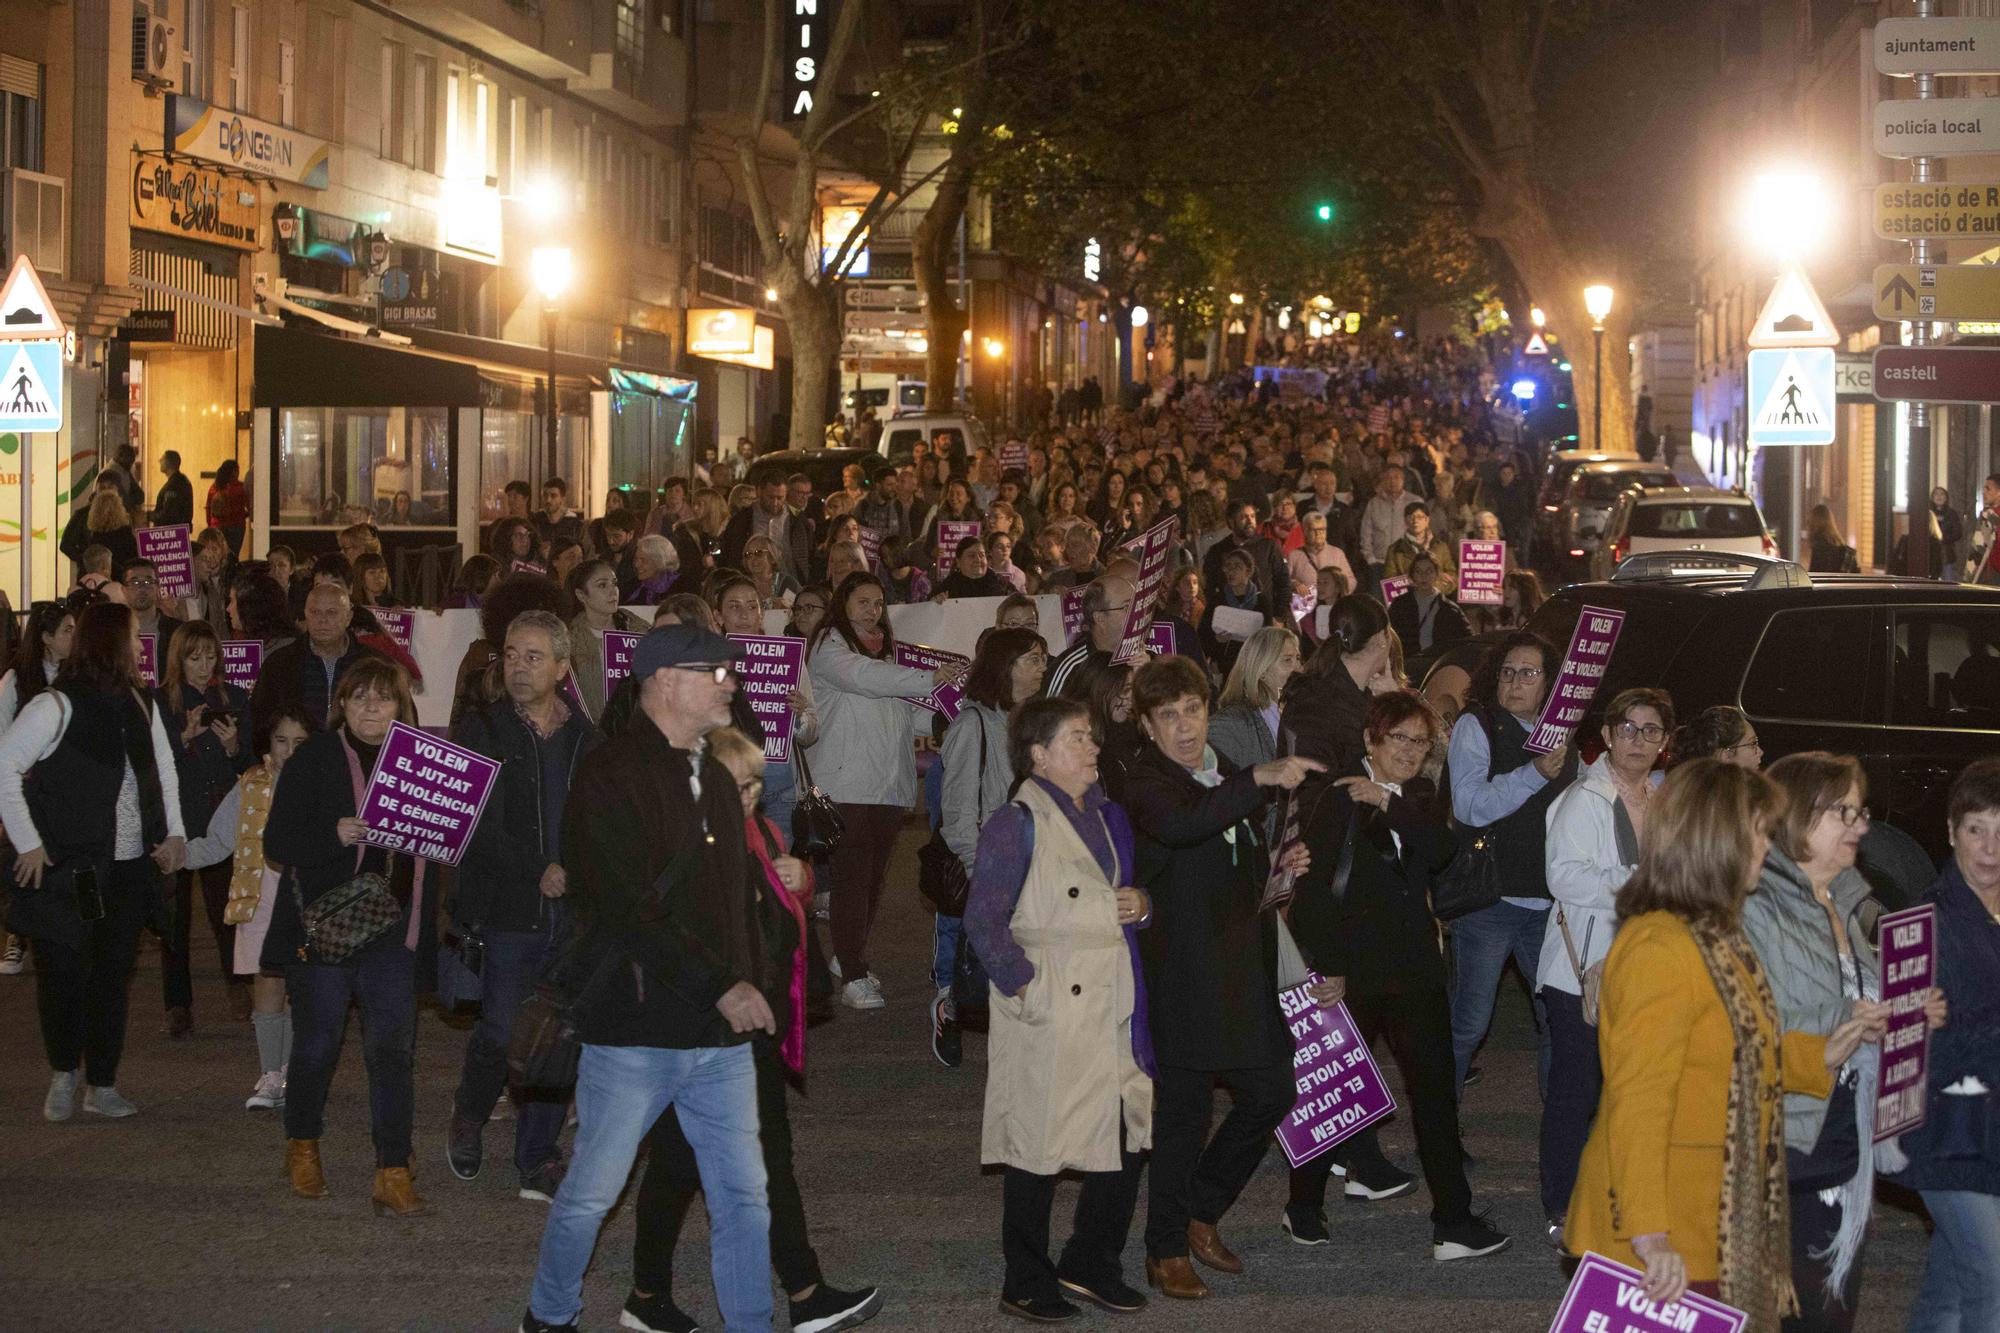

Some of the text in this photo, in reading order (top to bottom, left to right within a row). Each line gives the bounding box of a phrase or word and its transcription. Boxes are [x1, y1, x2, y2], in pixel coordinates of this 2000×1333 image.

[1885, 37, 1975, 55] ajuntament
[1885, 119, 1982, 137] policía local
[219, 116, 292, 167] DONGSAN
[1883, 187, 1951, 208] estació
[1957, 187, 1980, 207] de
[1882, 212, 1951, 233] estació
[384, 307, 437, 320] GIGI BRASAS
[1883, 365, 1937, 380] castell
[149, 530, 177, 540] VOLEM
[146, 541, 182, 552] EL JUTJAT
[1471, 543, 1494, 551] VOLEM
[384, 624, 405, 634] TJAT
[1590, 617, 1614, 634] VOLEM
[745, 642, 786, 657] VOLEM
[1578, 639, 1588, 653] EL
[615, 653, 628, 663] EL
[904, 652, 947, 669] DE GÈN
[225, 663, 253, 674] UTJAT
[607, 668, 621, 678] DE
[735, 661, 790, 676] EL JUTJAT
[1564, 660, 1576, 674] DE
[1561, 684, 1573, 698] DE
[749, 698, 786, 713] ÈNERE
[1556, 707, 1565, 720] A
[414, 740, 470, 773] VOLEM
[395, 756, 472, 794] EL JUTJAT
[376, 771, 476, 816] DE VIOLÈNCIA
[378, 794, 461, 830] DE GÈNERE
[378, 817, 445, 842] A XÀTIVA
[404, 839, 417, 852] A
[418, 841, 455, 861] UNA!
[1892, 921, 1924, 950] VOLEM
[1310, 1010, 1323, 1026] A
[1321, 1029, 1345, 1050] DE
[1884, 1030, 1896, 1054] DE
[1343, 1047, 1366, 1068] DE
[1291, 1075, 1366, 1127] EL JUTJAT
[1310, 1102, 1368, 1144] VOLEM
[1615, 1281, 1700, 1333] VOLEM
[1582, 1309, 1611, 1333] EL
